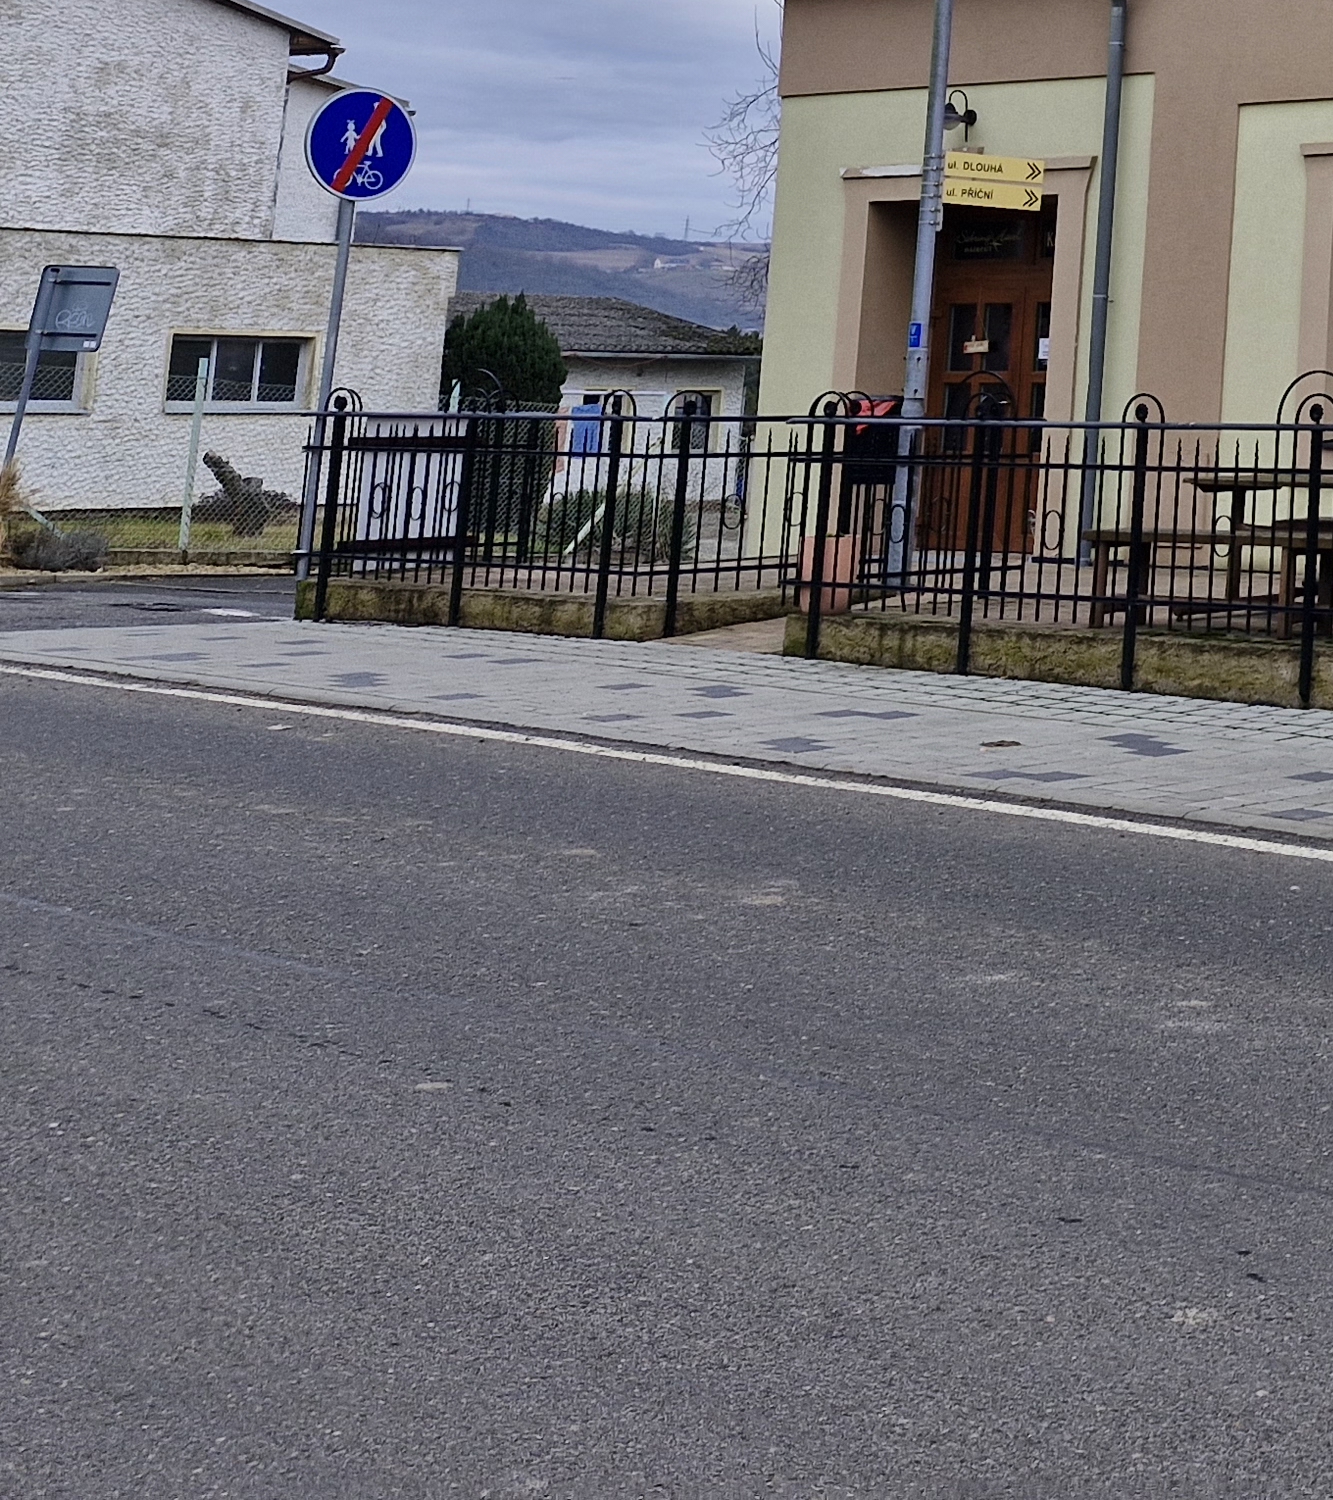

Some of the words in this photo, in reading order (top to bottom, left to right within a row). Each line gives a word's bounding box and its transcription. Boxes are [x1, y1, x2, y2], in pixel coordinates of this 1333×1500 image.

[947, 161, 958, 170] ul.
[963, 162, 1003, 173] DLOUHÁ
[946, 188, 957, 197] ul.
[961, 187, 994, 200] PŘÍČNÍ
